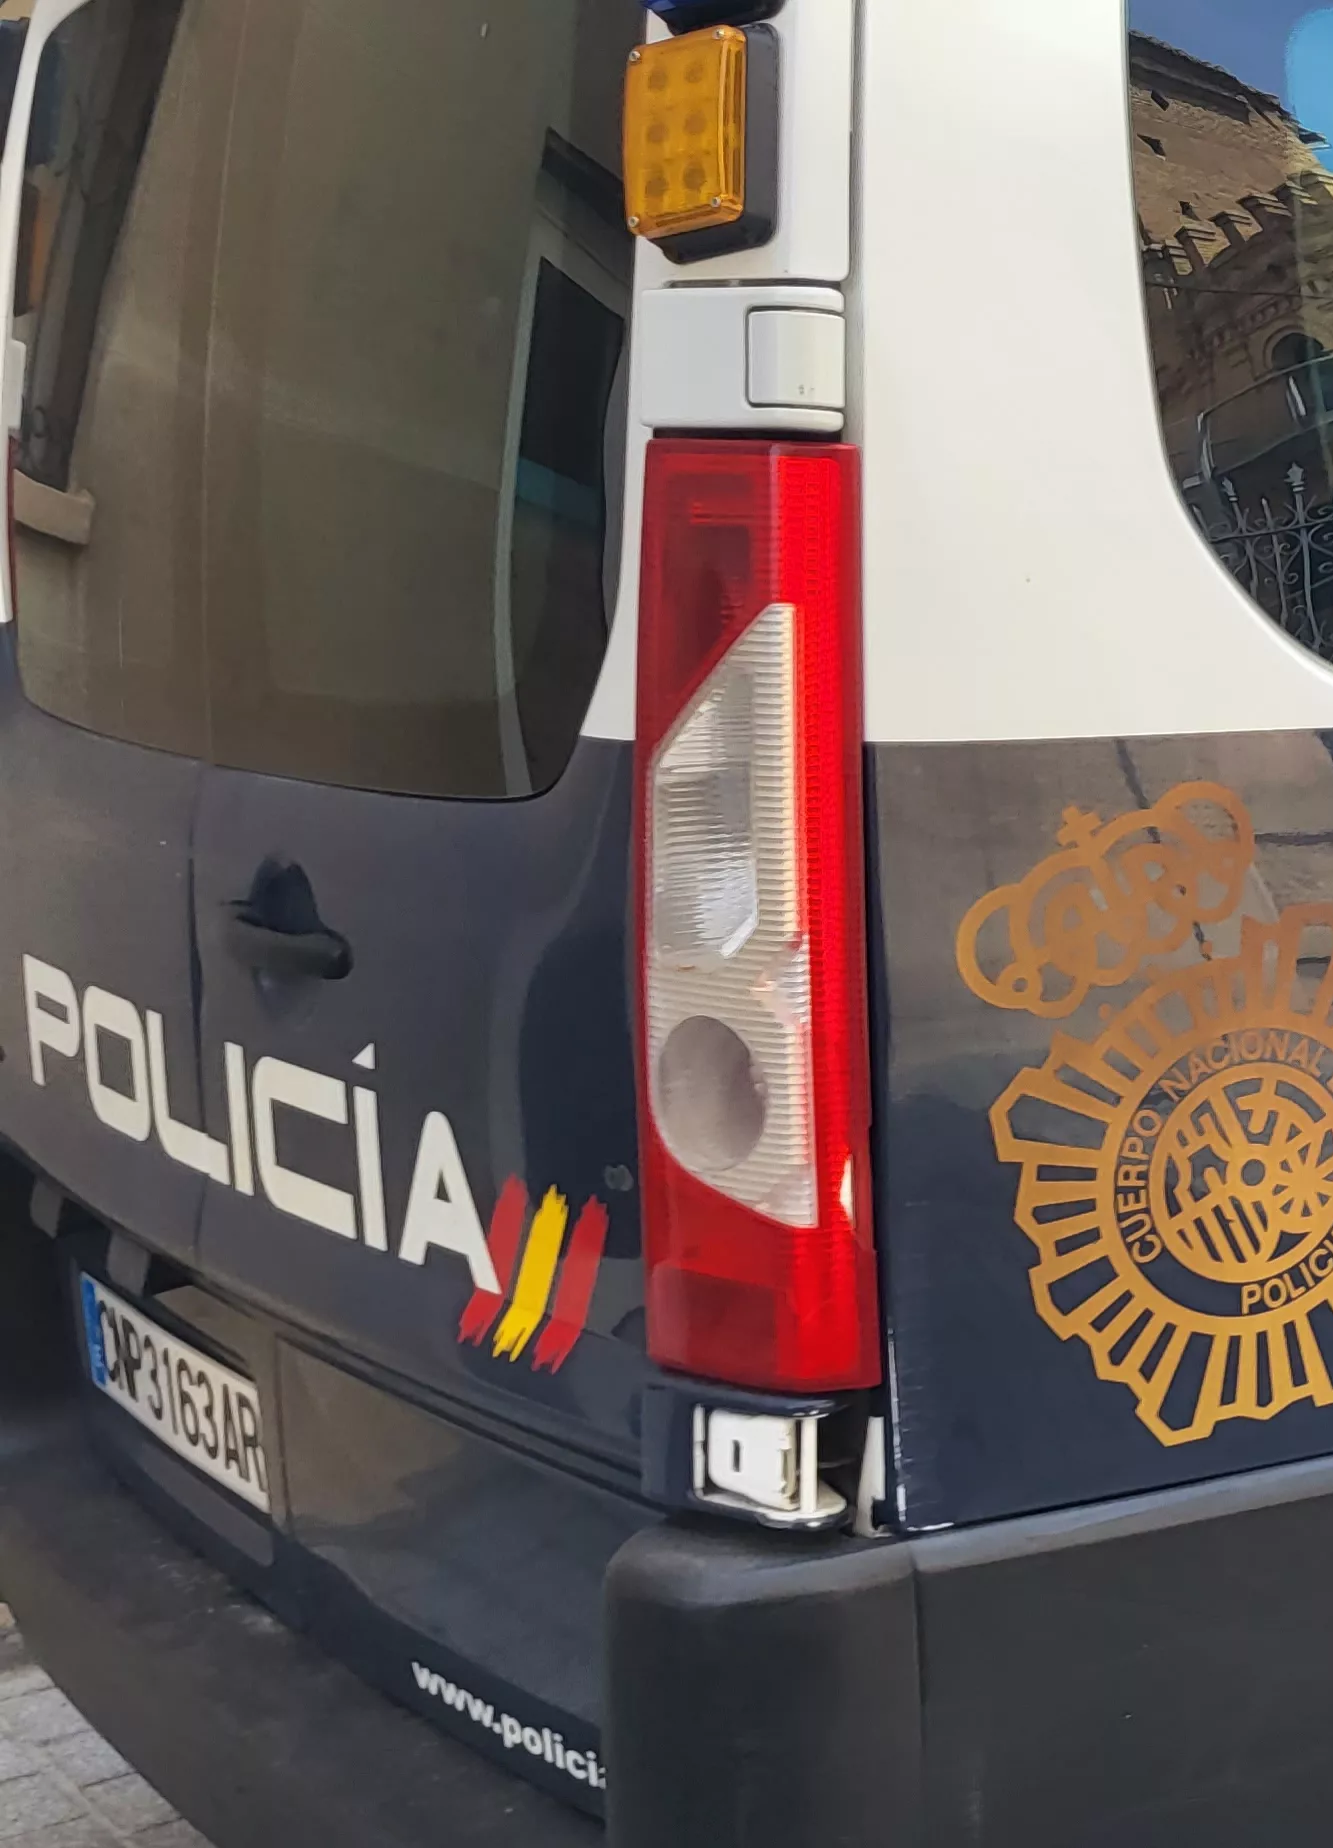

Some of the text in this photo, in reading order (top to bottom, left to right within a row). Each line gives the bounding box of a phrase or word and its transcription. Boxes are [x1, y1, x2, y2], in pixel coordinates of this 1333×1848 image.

[22, 953, 503, 1296] POLICÍA
[1115, 1107, 1165, 1265] CUERPO
[1156, 1030, 1323, 1102] NACIONAL
